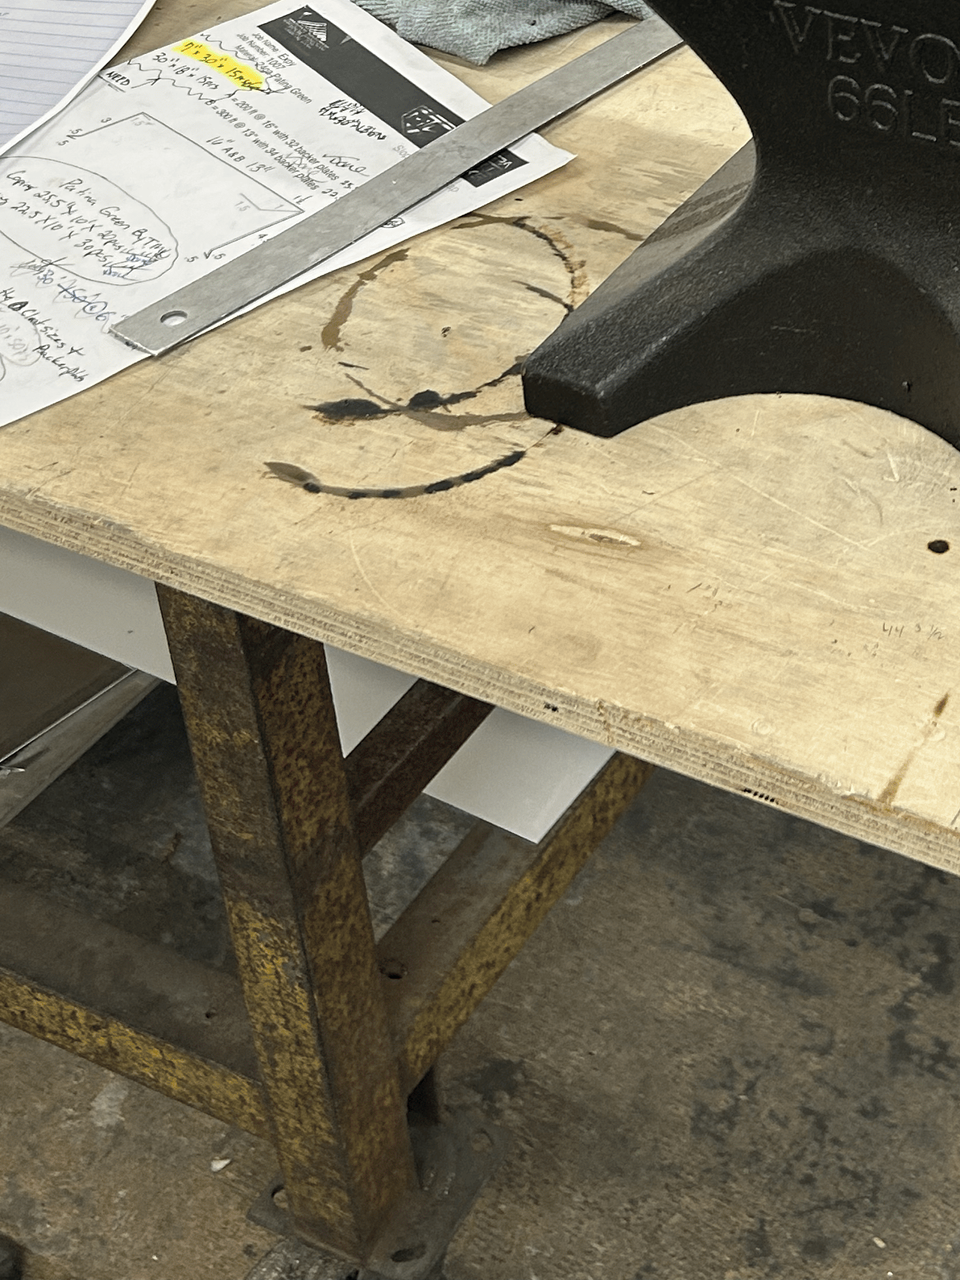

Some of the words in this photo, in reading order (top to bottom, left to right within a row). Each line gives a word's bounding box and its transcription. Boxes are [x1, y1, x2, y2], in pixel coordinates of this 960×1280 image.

[290, 86, 312, 105] Green
[252, 135, 269, 150] with
[265, 145, 280, 155] 34
[273, 127, 289, 142] with
[285, 137, 300, 150] 32
[295, 143, 320, 167] backer
[315, 161, 340, 182] plates
[100, 206, 130, 230] Green
